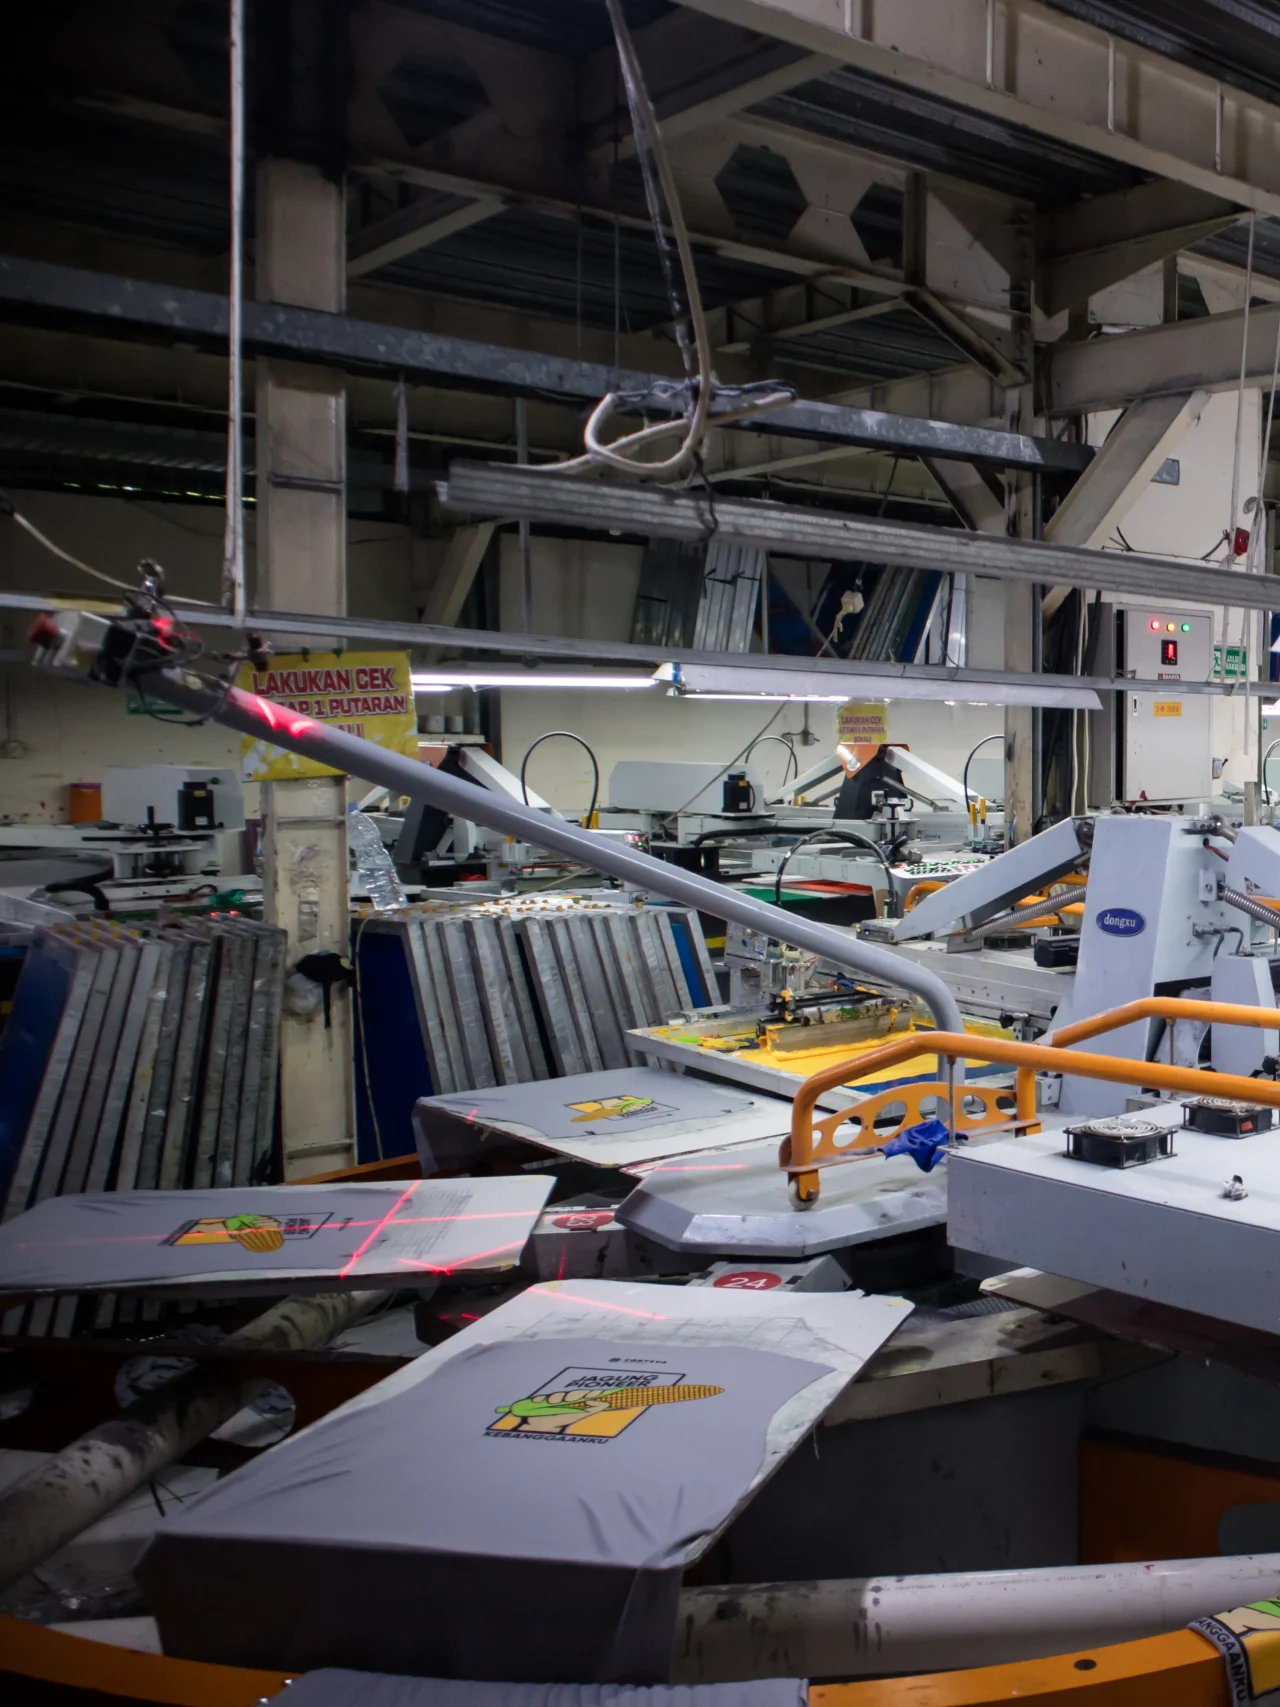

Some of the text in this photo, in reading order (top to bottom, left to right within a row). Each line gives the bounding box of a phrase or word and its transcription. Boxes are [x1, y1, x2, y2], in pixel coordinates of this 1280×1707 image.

[253, 667, 397, 695] LAKUKAN CEK
[314, 699, 326, 717] 1
[329, 695, 406, 717] PUTARAN
[1103, 913, 1136, 929] dongxu
[723, 1277, 768, 1288] 24
[564, 1379, 651, 1388] PIONEER
[575, 1374, 659, 1383] JAGUNG
[482, 1430, 611, 1445] KEBANGGAANKU
